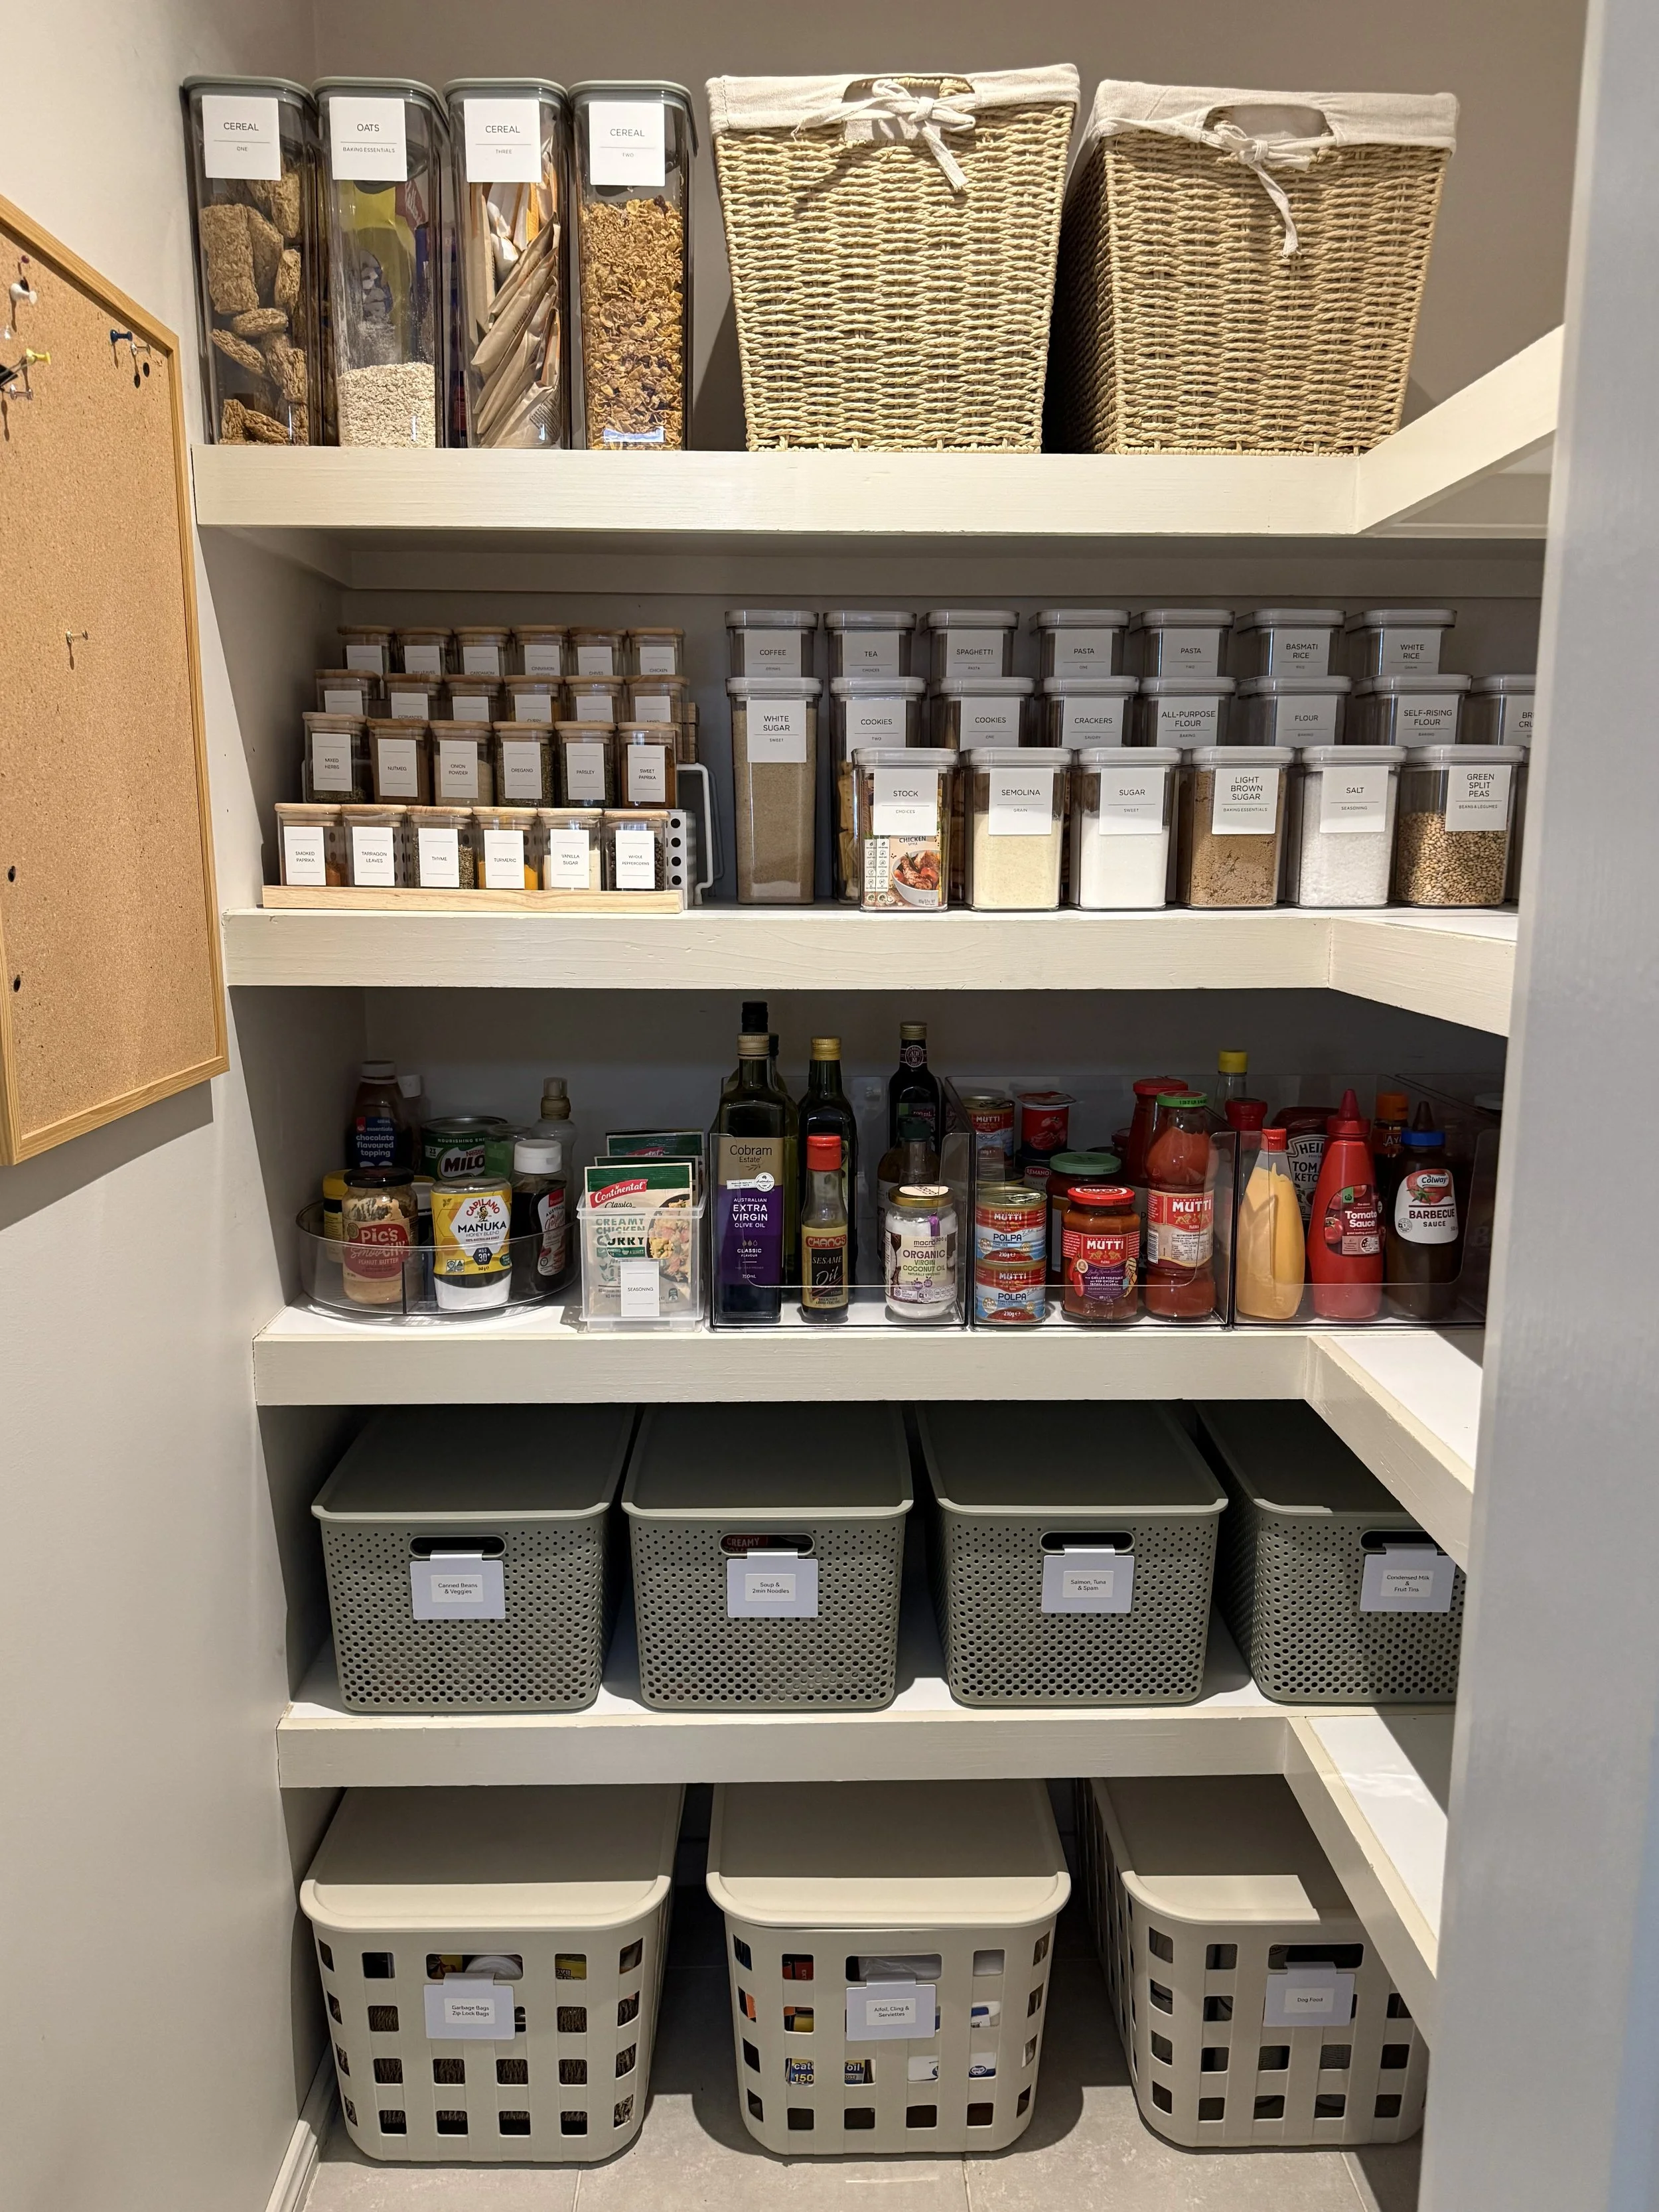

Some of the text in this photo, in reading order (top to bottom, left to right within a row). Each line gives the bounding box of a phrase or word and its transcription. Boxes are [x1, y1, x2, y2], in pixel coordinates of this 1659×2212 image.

[223, 122, 259, 131] CEREAL
[360, 1149, 390, 1157] topping
[730, 1145, 772, 1155] Cobram
[445, 1155, 485, 1172] MILO
[1421, 1176, 1447, 1185] Colway
[595, 1181, 643, 1203] Continental
[467, 1199, 500, 1216] CAPILANO
[1173, 1201, 1211, 1213] MUTTI
[1344, 1211, 1377, 1219] Tomato
[1409, 1209, 1455, 1219] BARBECUE
[458, 1221, 506, 1233] MANUKA
[596, 1226, 645, 1234] CHICKEN
[1087, 1240, 1123, 1250] MUTTI
[902, 1250, 946, 1259] ORGANIC
[812, 1256, 842, 1264] SESAME
[816, 1266, 838, 1286] Oil
[727, 1538, 759, 1546] CREAMY
